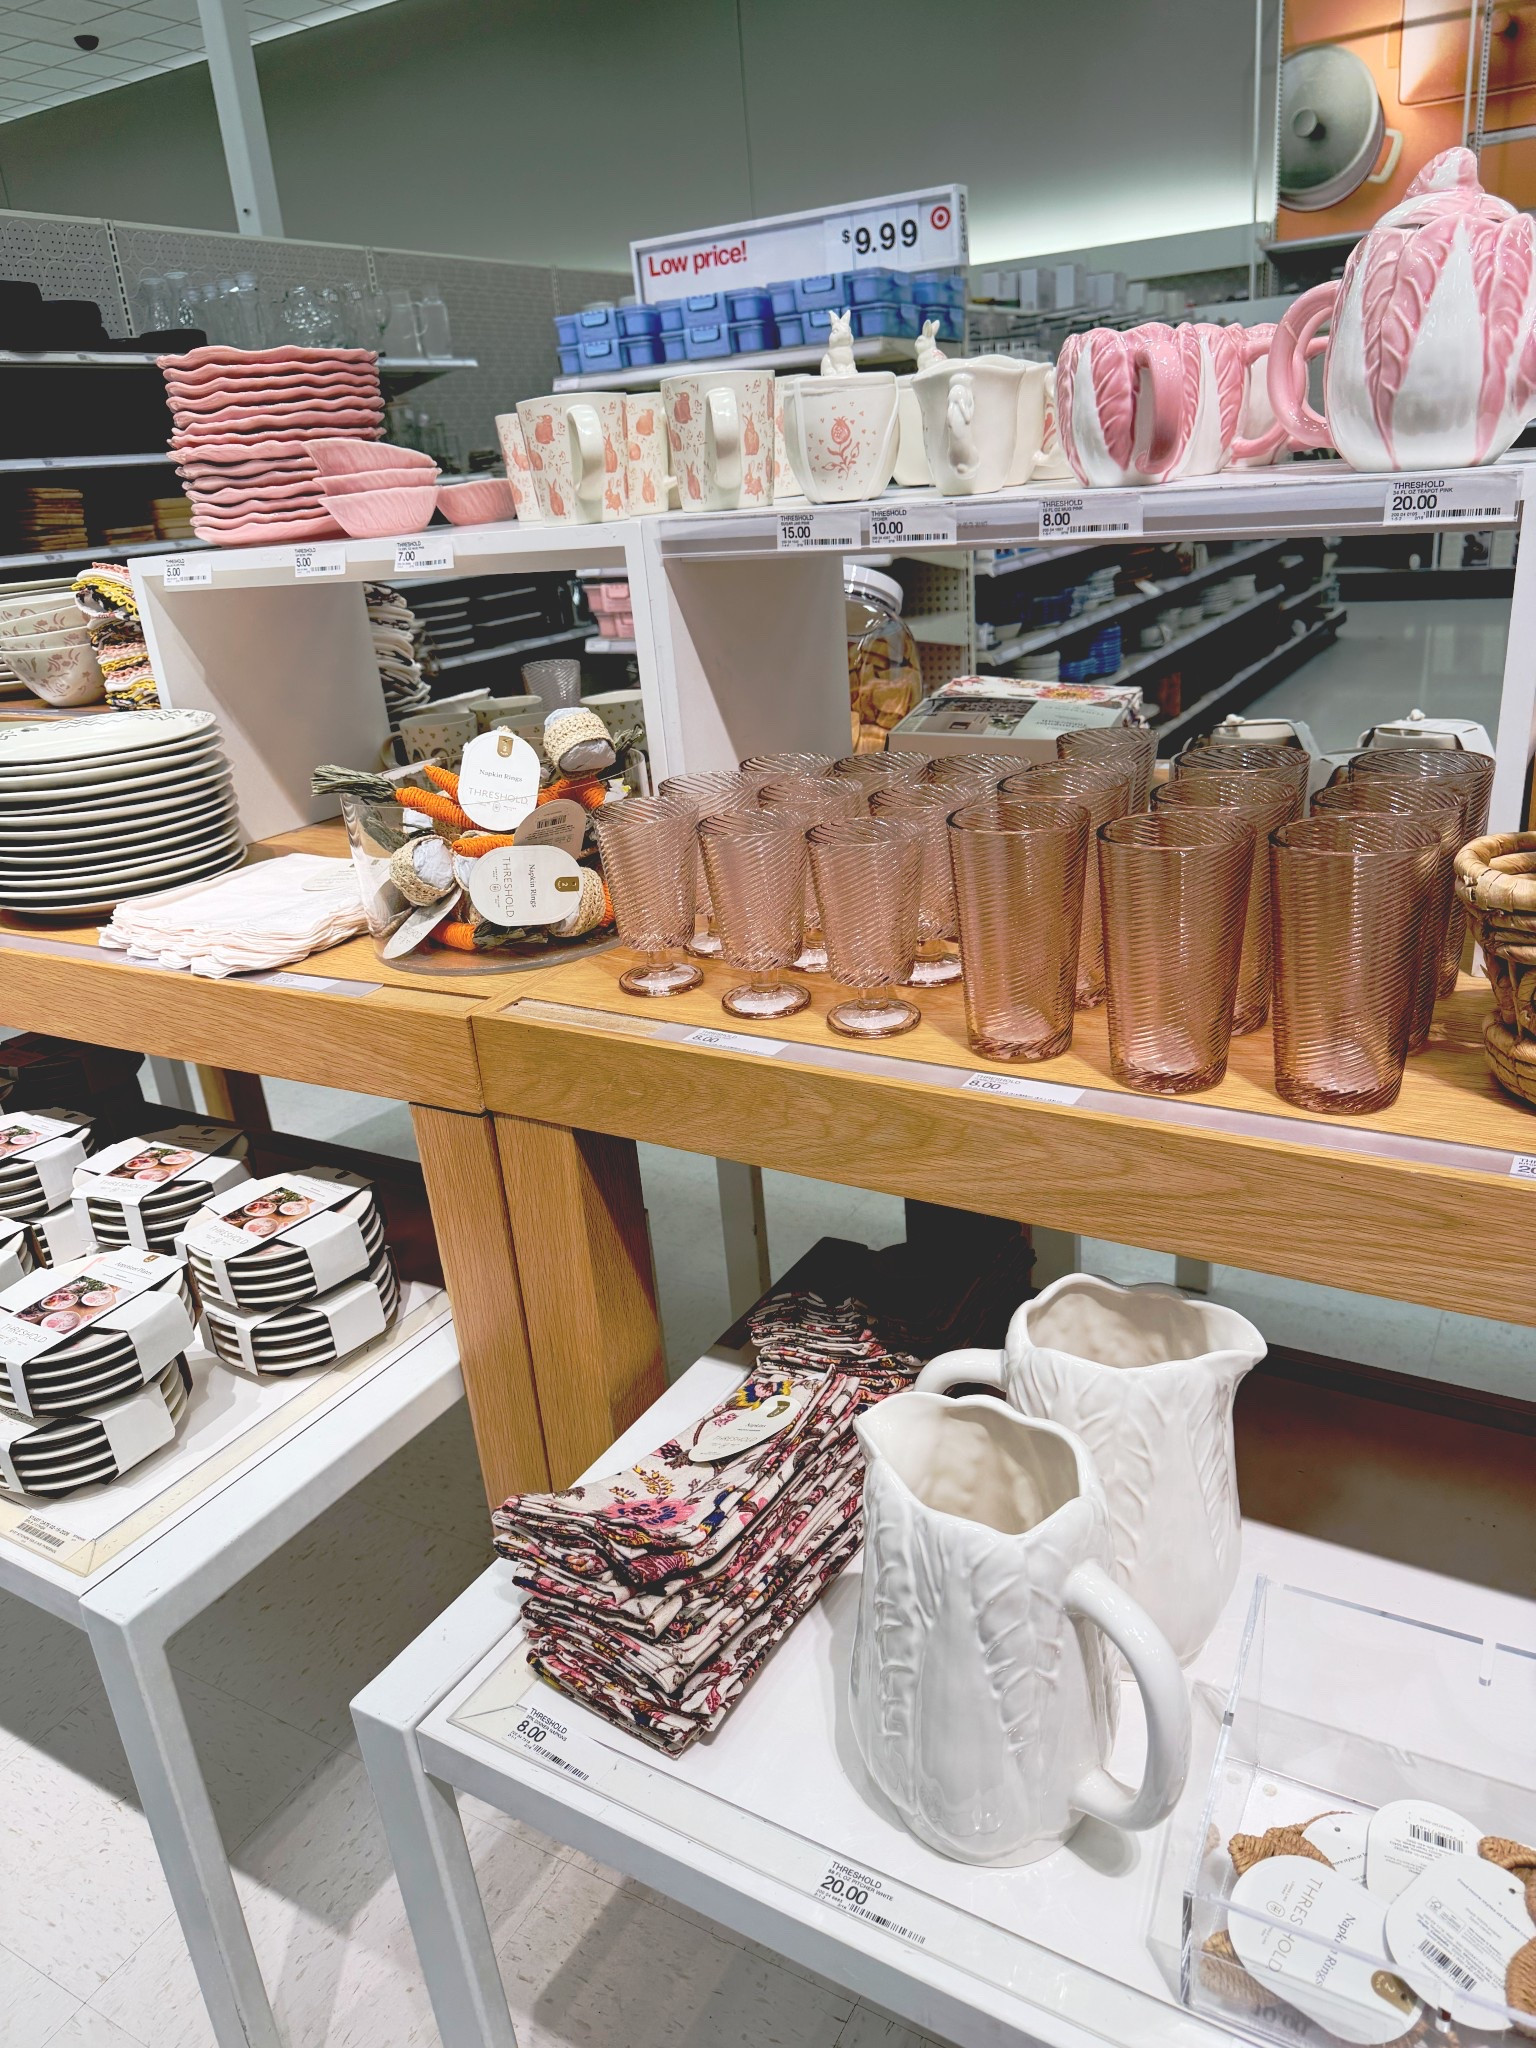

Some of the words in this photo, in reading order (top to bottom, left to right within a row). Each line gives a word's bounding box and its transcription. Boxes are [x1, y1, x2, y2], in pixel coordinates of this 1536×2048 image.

[842, 218, 918, 255] $9.99
[648, 256, 688, 277] Low
[693, 240, 748, 275] price!
[1394, 480, 1445, 489] THRESHOLD
[1042, 500, 1083, 508] THRESHOLD
[1392, 494, 1437, 511] 20.00
[780, 514, 814, 522] THRESHOLD
[1043, 512, 1070, 526] 8.00
[782, 526, 811, 539] 15.00
[872, 522, 903, 534] 10.00
[296, 557, 312, 568] 5.00
[398, 550, 416, 562] 7.00
[166, 568, 180, 576] 5.00
[479, 769, 503, 779] Napkin
[504, 773, 523, 783] Rings
[469, 787, 528, 805] THRESHOLD
[528, 864, 536, 888] Napkin
[502, 856, 514, 918] THRESHOLD
[4, 1323, 48, 1344] THRESHOLD
[530, 1708, 568, 1734] THRESHOLD
[516, 1720, 547, 1743] 8.00
[832, 1860, 882, 1889] THRESHOLD
[820, 1875, 869, 1906] 20.00
[851, 1878, 875, 1894] PITCHER
[876, 1890, 894, 1902] WHITE
[1268, 1878, 1324, 1973] THRESHOLD
[1315, 1955, 1337, 1987] Rings
